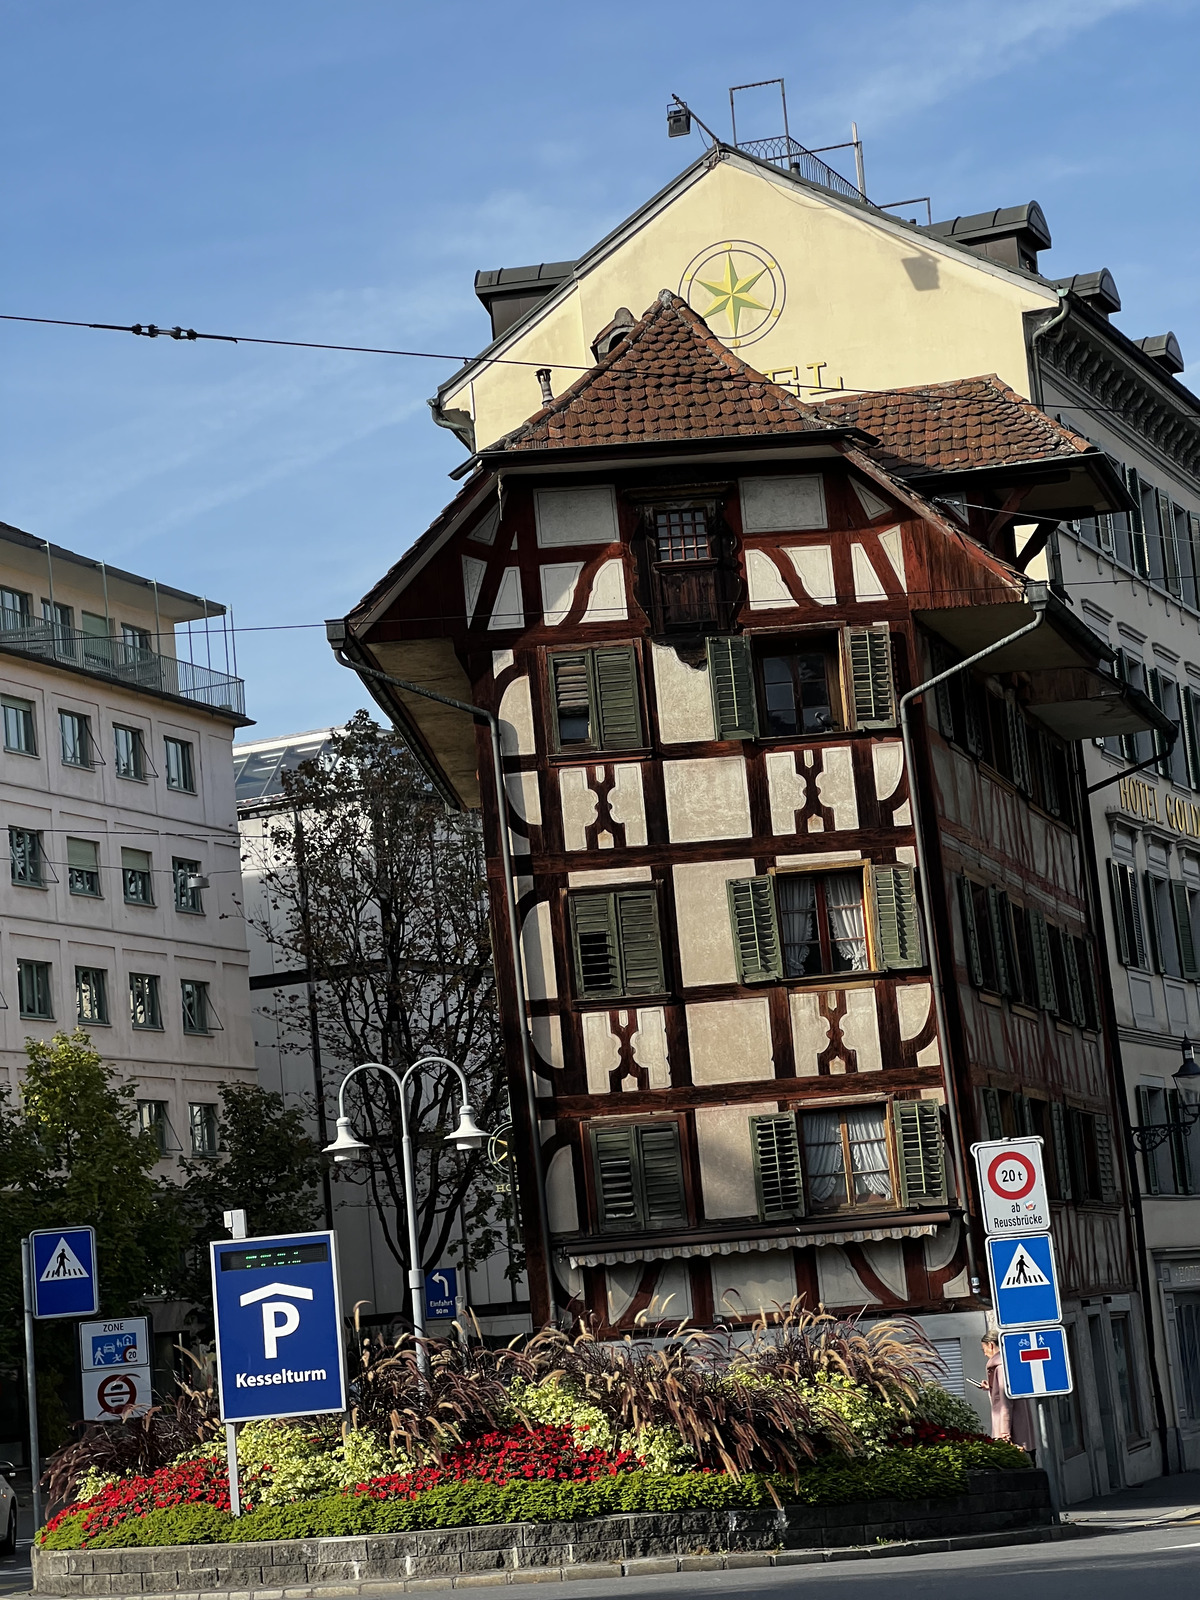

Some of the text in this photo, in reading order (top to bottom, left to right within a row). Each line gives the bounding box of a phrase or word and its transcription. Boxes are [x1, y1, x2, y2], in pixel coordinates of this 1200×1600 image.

[1119, 776, 1164, 825] HOTEL
[1001, 1169, 1023, 1183] 20 t
[1011, 1202, 1021, 1213] ab
[993, 1213, 1043, 1229] Reussbrücke
[430, 1299, 454, 1308] Einfahrt
[103, 1322, 125, 1333] ZONE
[261, 1301, 301, 1360] P
[128, 1351, 137, 1359] 20
[235, 1368, 327, 1388] Kesselturm
